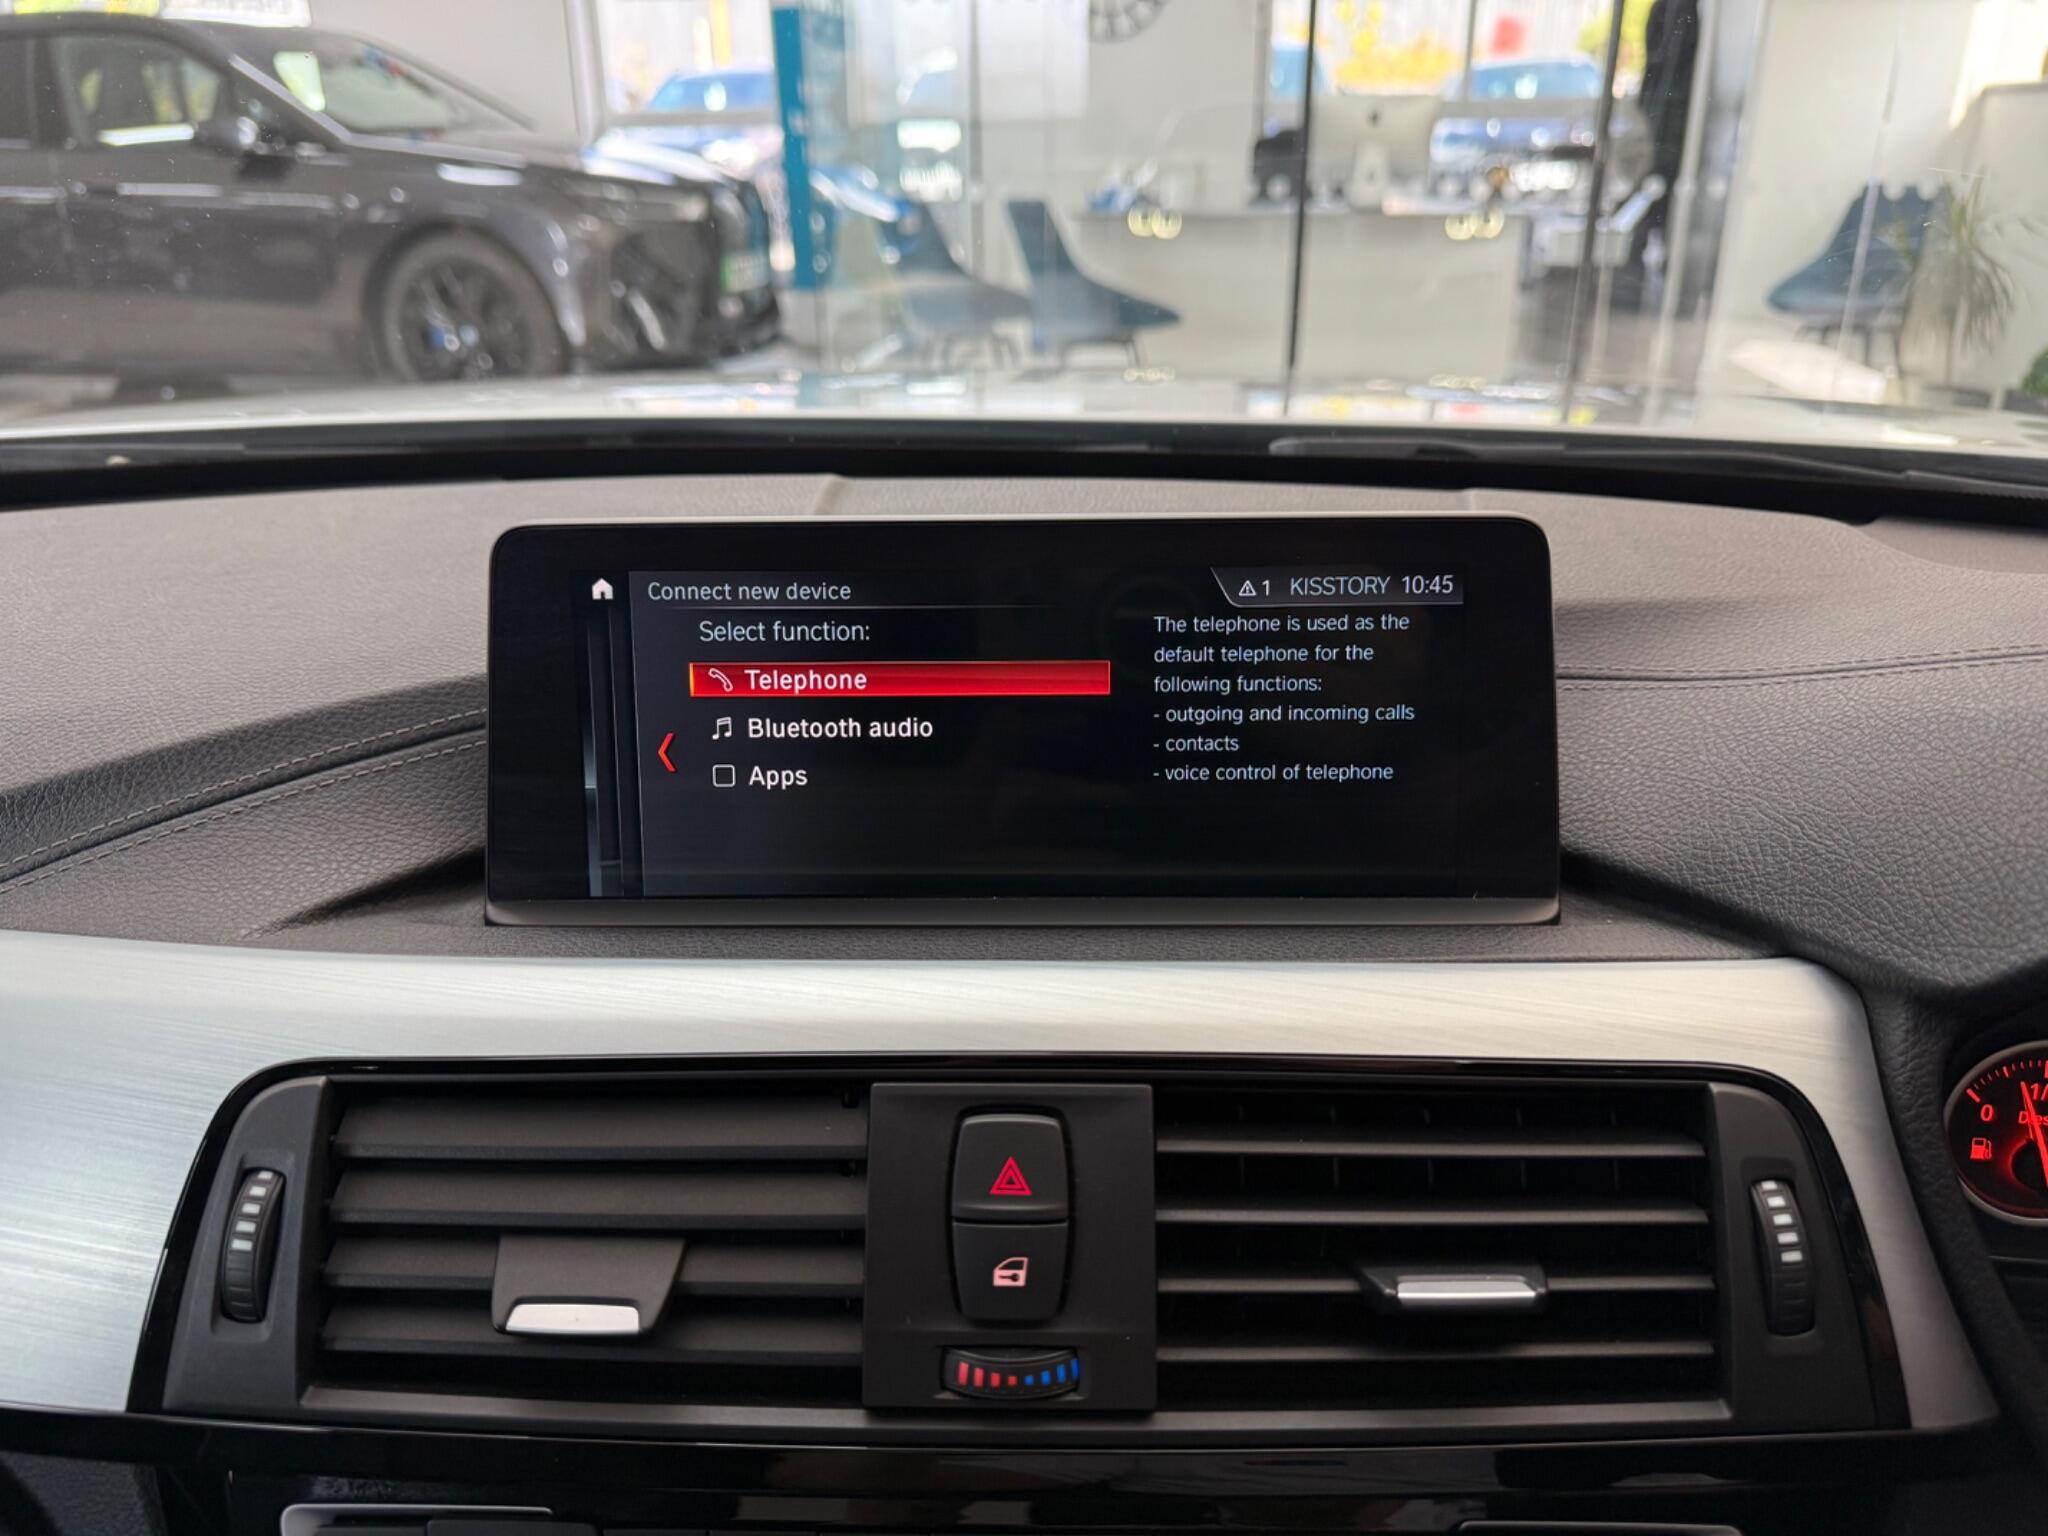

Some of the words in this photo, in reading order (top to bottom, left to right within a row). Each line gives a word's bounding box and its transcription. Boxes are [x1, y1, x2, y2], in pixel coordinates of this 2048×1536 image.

[647, 581, 732, 601] Connect
[738, 585, 780, 601] new
[785, 582, 852, 601] device
[1261, 579, 1271, 597] 1
[1290, 576, 1391, 596] KISSTORY
[1401, 574, 1454, 594] 10:45
[699, 620, 766, 642] Select
[772, 620, 870, 642] function:
[1153, 615, 1187, 633] The
[1193, 615, 1281, 635] telephone
[1287, 614, 1301, 632] is
[1307, 614, 1349, 631] used
[1354, 617, 1375, 631] as
[1380, 613, 1410, 630] the
[1154, 646, 1214, 663] default
[1220, 645, 1309, 665] telephone
[1314, 644, 1340, 661] for
[1345, 644, 1374, 661] the
[743, 669, 867, 694] Telephone
[1154, 675, 1231, 696] following
[1237, 675, 1322, 692] functions:
[1165, 705, 1243, 725] outgoing
[1249, 705, 1282, 722] and
[1288, 704, 1369, 724] incoming
[1374, 703, 1415, 721] calls
[747, 717, 862, 739] Bluetooth
[868, 716, 933, 738] audio
[1165, 735, 1240, 752] contacts
[748, 765, 808, 791] Apps
[1165, 764, 1210, 781] voice
[1215, 764, 1276, 781] control
[1282, 763, 1300, 780] of
[1305, 764, 1394, 783] telephone
[1980, 1103, 1995, 1122] 0
